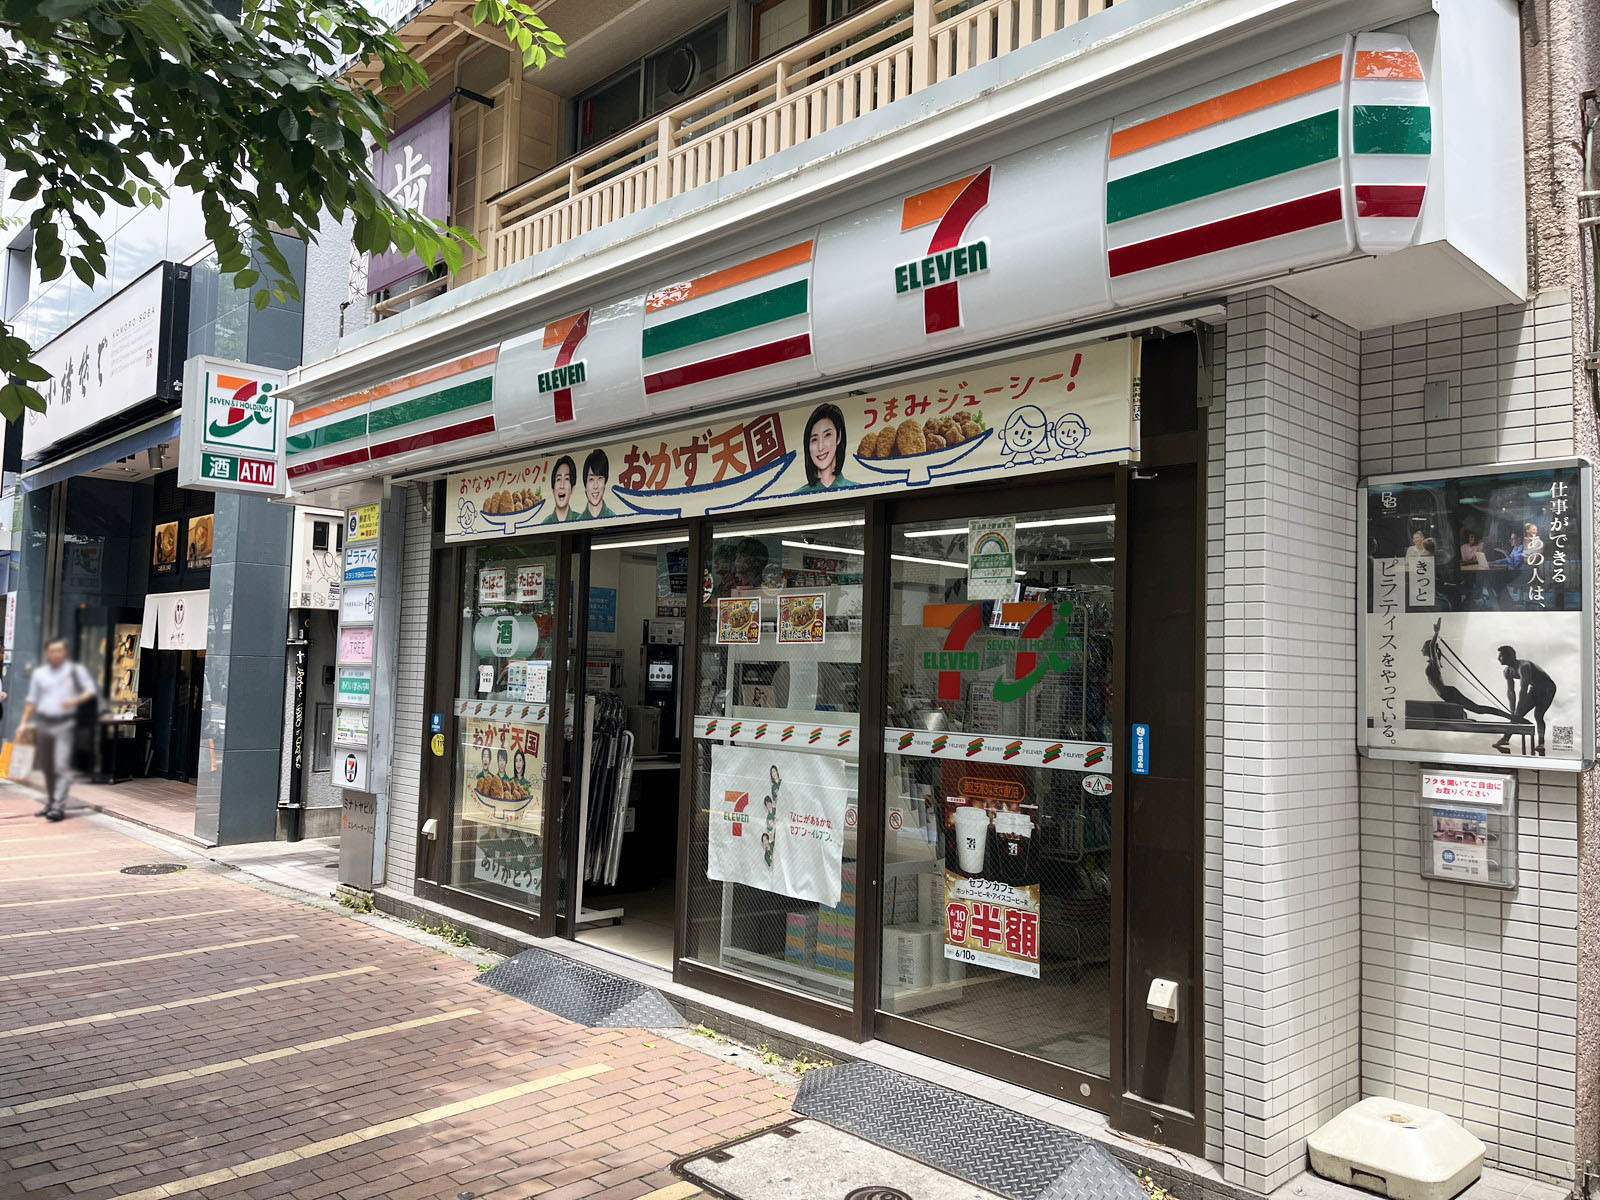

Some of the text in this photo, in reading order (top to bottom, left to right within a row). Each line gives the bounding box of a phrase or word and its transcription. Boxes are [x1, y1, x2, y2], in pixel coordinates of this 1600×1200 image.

[618, 412, 787, 491] おかず天国
[209, 456, 273, 483] 酒 ATM
[1550, 481, 1568, 583] 仕事ができる
[346, 548, 378, 566] ピラティス
[519, 572, 543, 587] たばこ
[1414, 560, 1430, 602] きっと
[497, 620, 513, 645] 酒
[1378, 558, 1399, 746] ピラティスをやっている。
[472, 722, 540, 758] おかず天国
[1424, 776, 1502, 791] フタを開いてご自由に
[1435, 787, 1490, 798] お取りください
[344, 798, 374, 815] ミナトヤビル
[968, 879, 1015, 895] セブンカフェ
[949, 909, 966, 922] 6/10
[972, 903, 1037, 959] 半額
[955, 949, 972, 961] 6/10
